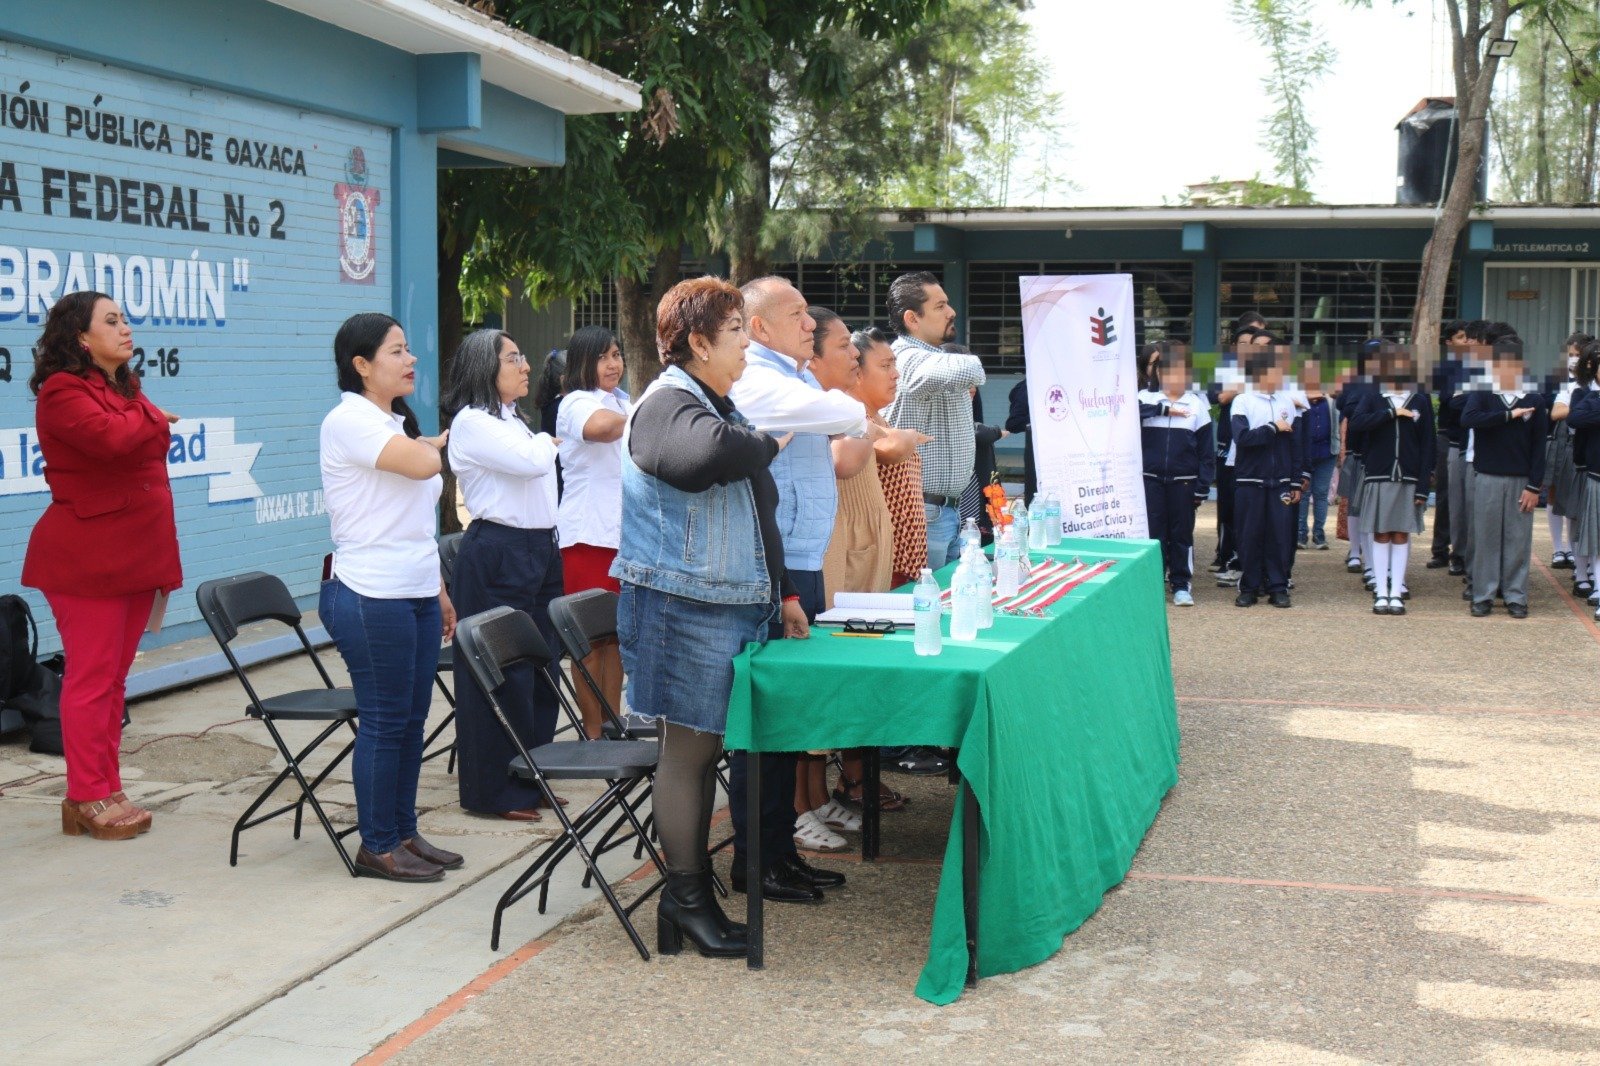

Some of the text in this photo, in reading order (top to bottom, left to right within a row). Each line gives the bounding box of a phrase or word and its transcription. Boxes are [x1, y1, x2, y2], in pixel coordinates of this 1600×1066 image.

[65, 93, 172, 154] PÚBLICA
[185, 128, 214, 162] DE
[225, 137, 307, 177] OAXACA
[42, 167, 210, 232] FEDERAL
[268, 200, 286, 240] 2
[256, 493, 295, 524] OAXACA
[296, 491, 309, 518] DE
[1111, 498, 1120, 509] de
